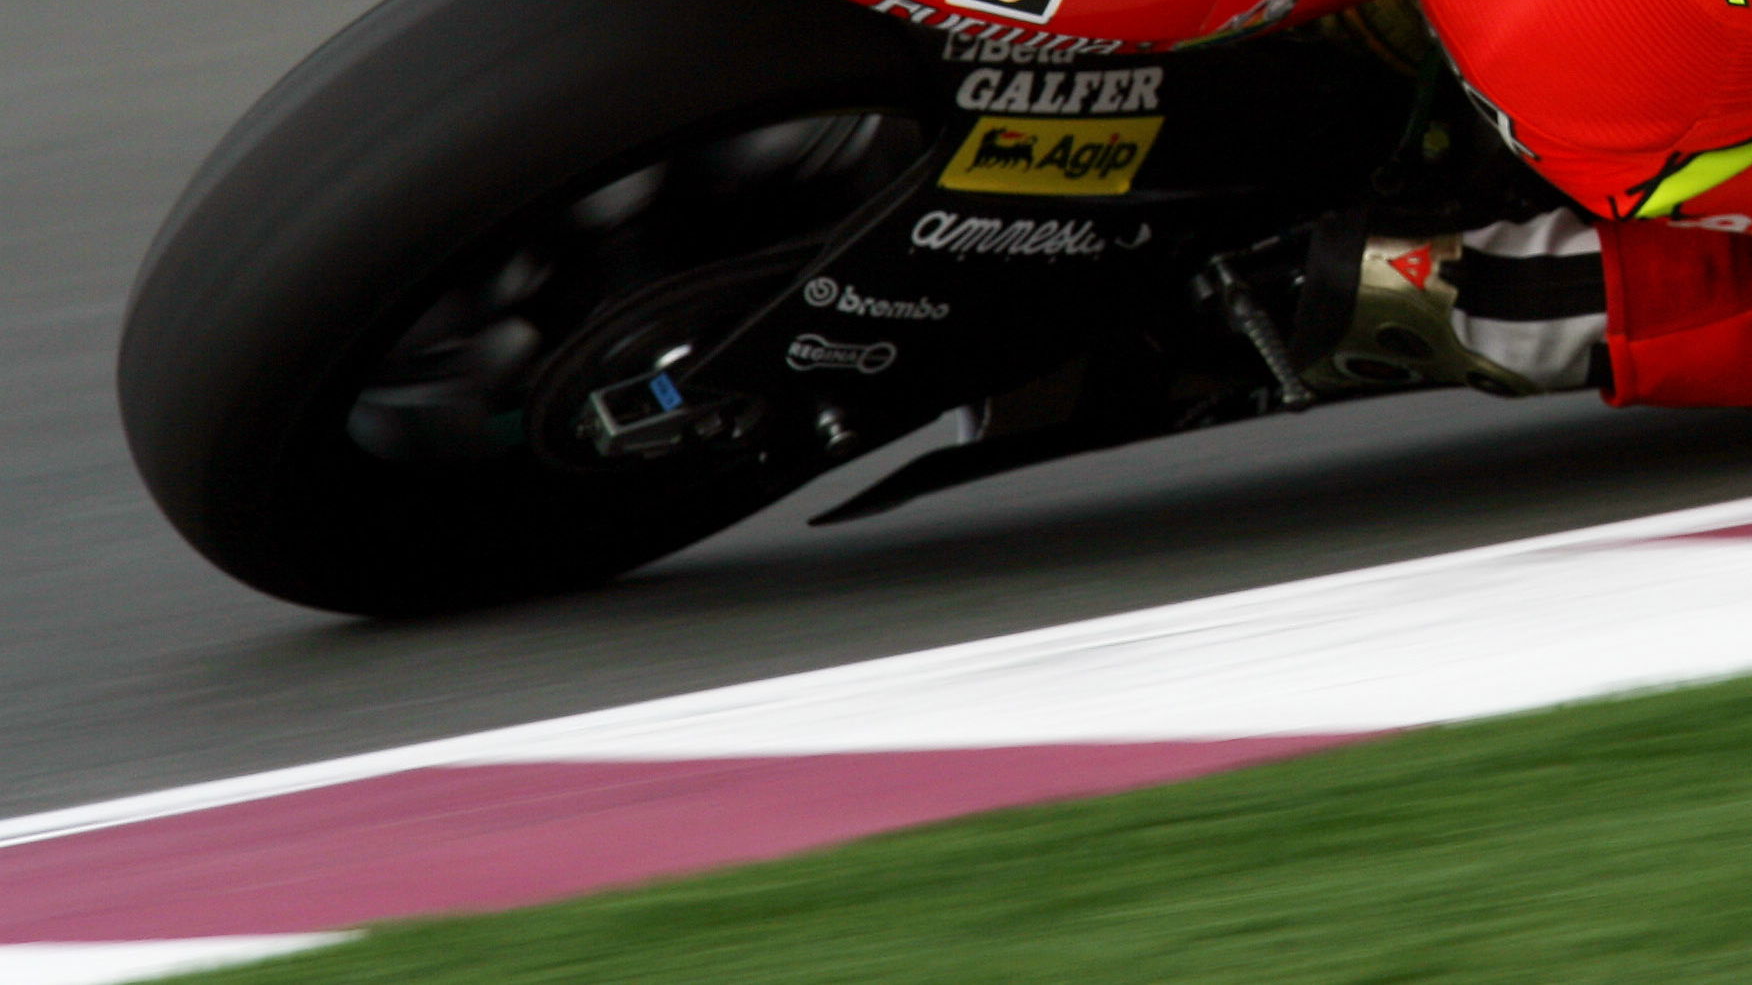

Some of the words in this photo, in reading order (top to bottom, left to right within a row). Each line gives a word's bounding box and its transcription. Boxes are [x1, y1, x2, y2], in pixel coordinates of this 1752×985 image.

[955, 67, 1163, 113] GALFER
[1036, 133, 1138, 179] Agip
[838, 285, 950, 320] brembo
